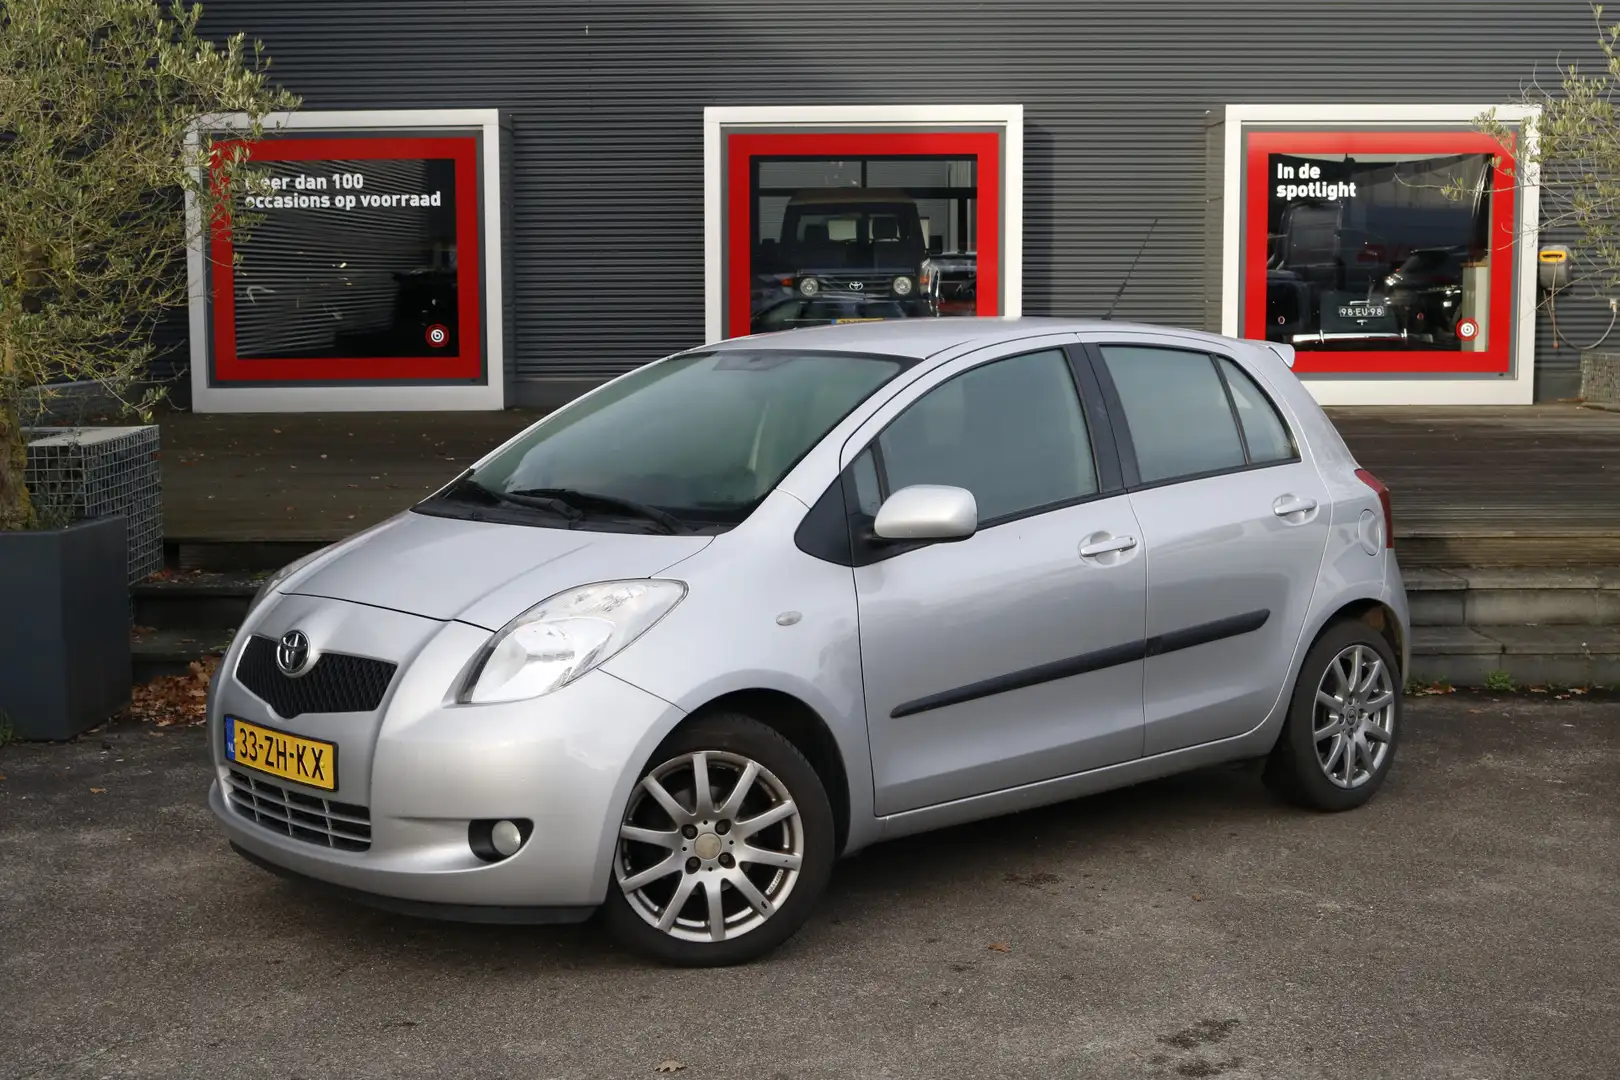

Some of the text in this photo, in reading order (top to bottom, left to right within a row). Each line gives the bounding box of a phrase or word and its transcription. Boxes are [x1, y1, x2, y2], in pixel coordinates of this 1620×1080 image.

[1277, 163, 1321, 179] In de
[295, 174, 327, 190] dan
[332, 173, 364, 189] 100
[1276, 181, 1357, 201] spotlight
[245, 190, 441, 211] occasions op voorraad
[227, 742, 235, 753] NL
[240, 727, 325, 781] 33-ZH-KX
